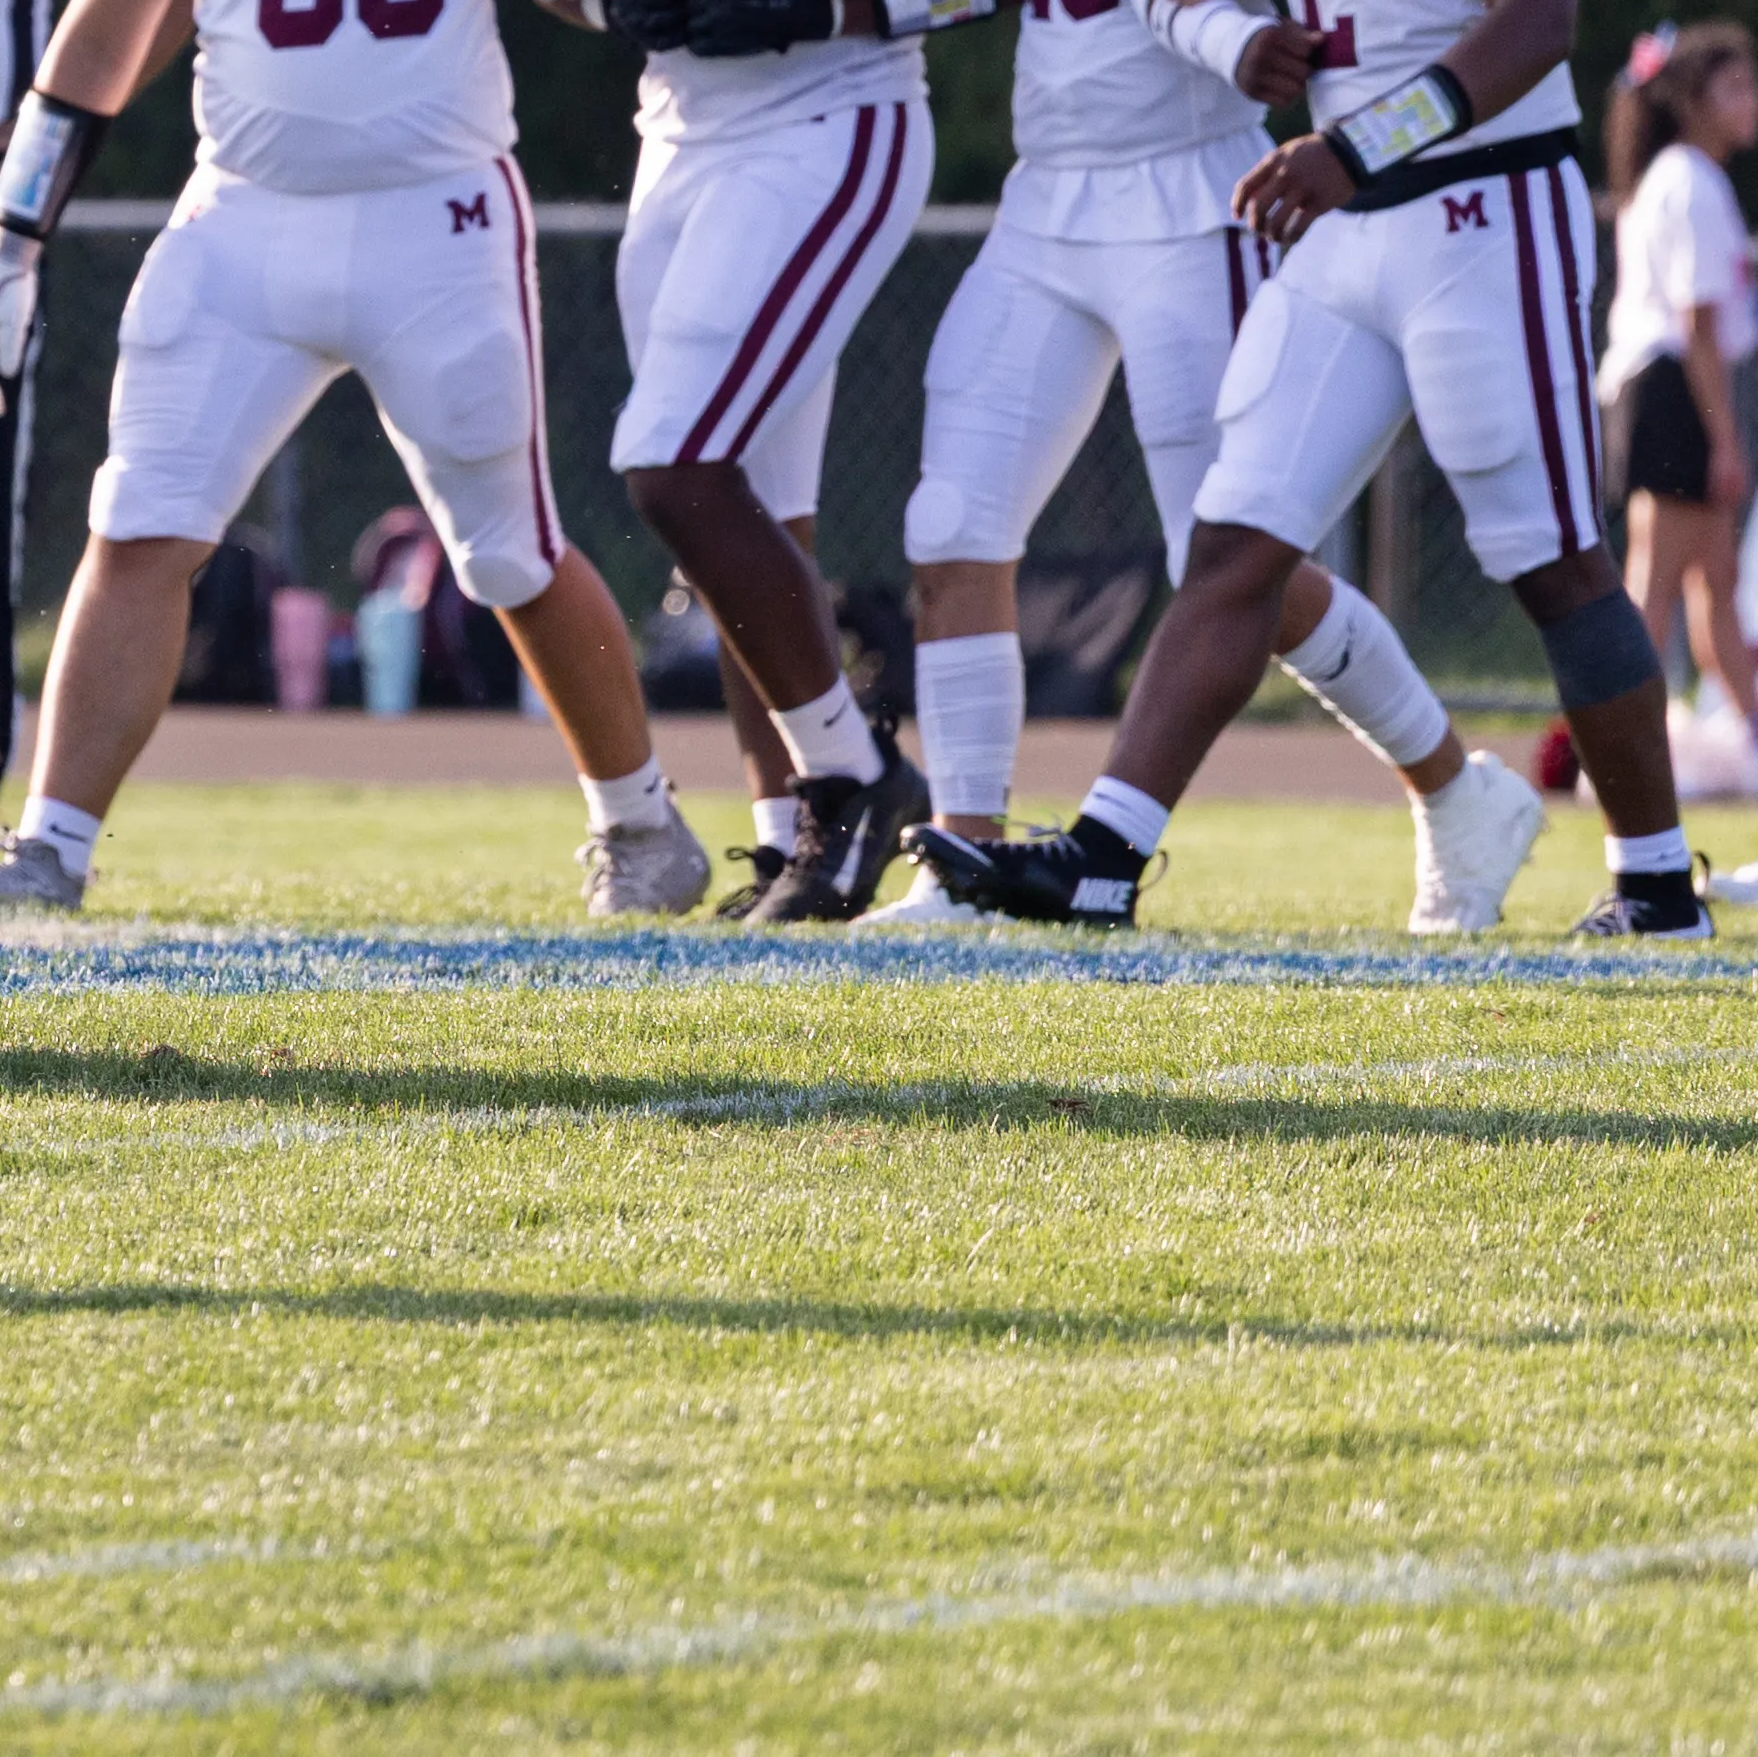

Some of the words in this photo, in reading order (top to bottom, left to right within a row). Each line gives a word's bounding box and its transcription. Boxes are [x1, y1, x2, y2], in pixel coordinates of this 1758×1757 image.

[446, 192, 490, 233] M
[1441, 191, 1489, 232] M
[1070, 876, 1133, 913] NIKE
